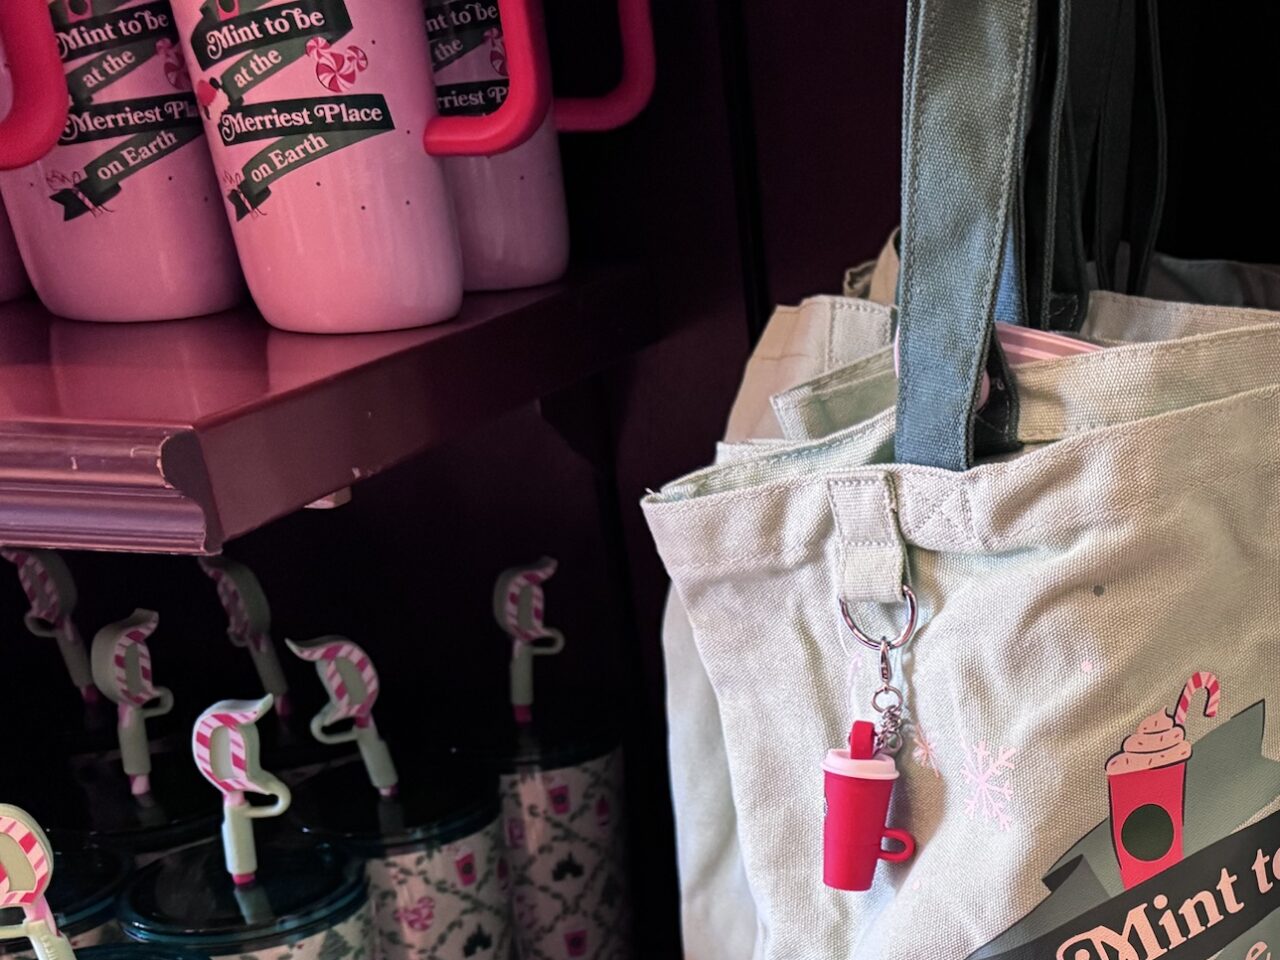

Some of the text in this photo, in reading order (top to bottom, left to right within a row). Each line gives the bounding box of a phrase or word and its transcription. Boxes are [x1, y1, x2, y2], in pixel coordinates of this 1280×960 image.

[206, 7, 325, 60] Mint to be
[450, 10, 472, 26] to
[465, 2, 498, 20] be
[55, 10, 169, 58] Mint to be
[434, 39, 464, 61] the
[83, 51, 136, 88] at the
[234, 49, 282, 88] at the
[60, 106, 164, 140] Merriest
[222, 103, 383, 142] Merriest Place
[97, 130, 177, 180] on Earth
[251, 133, 329, 182] on Earth
